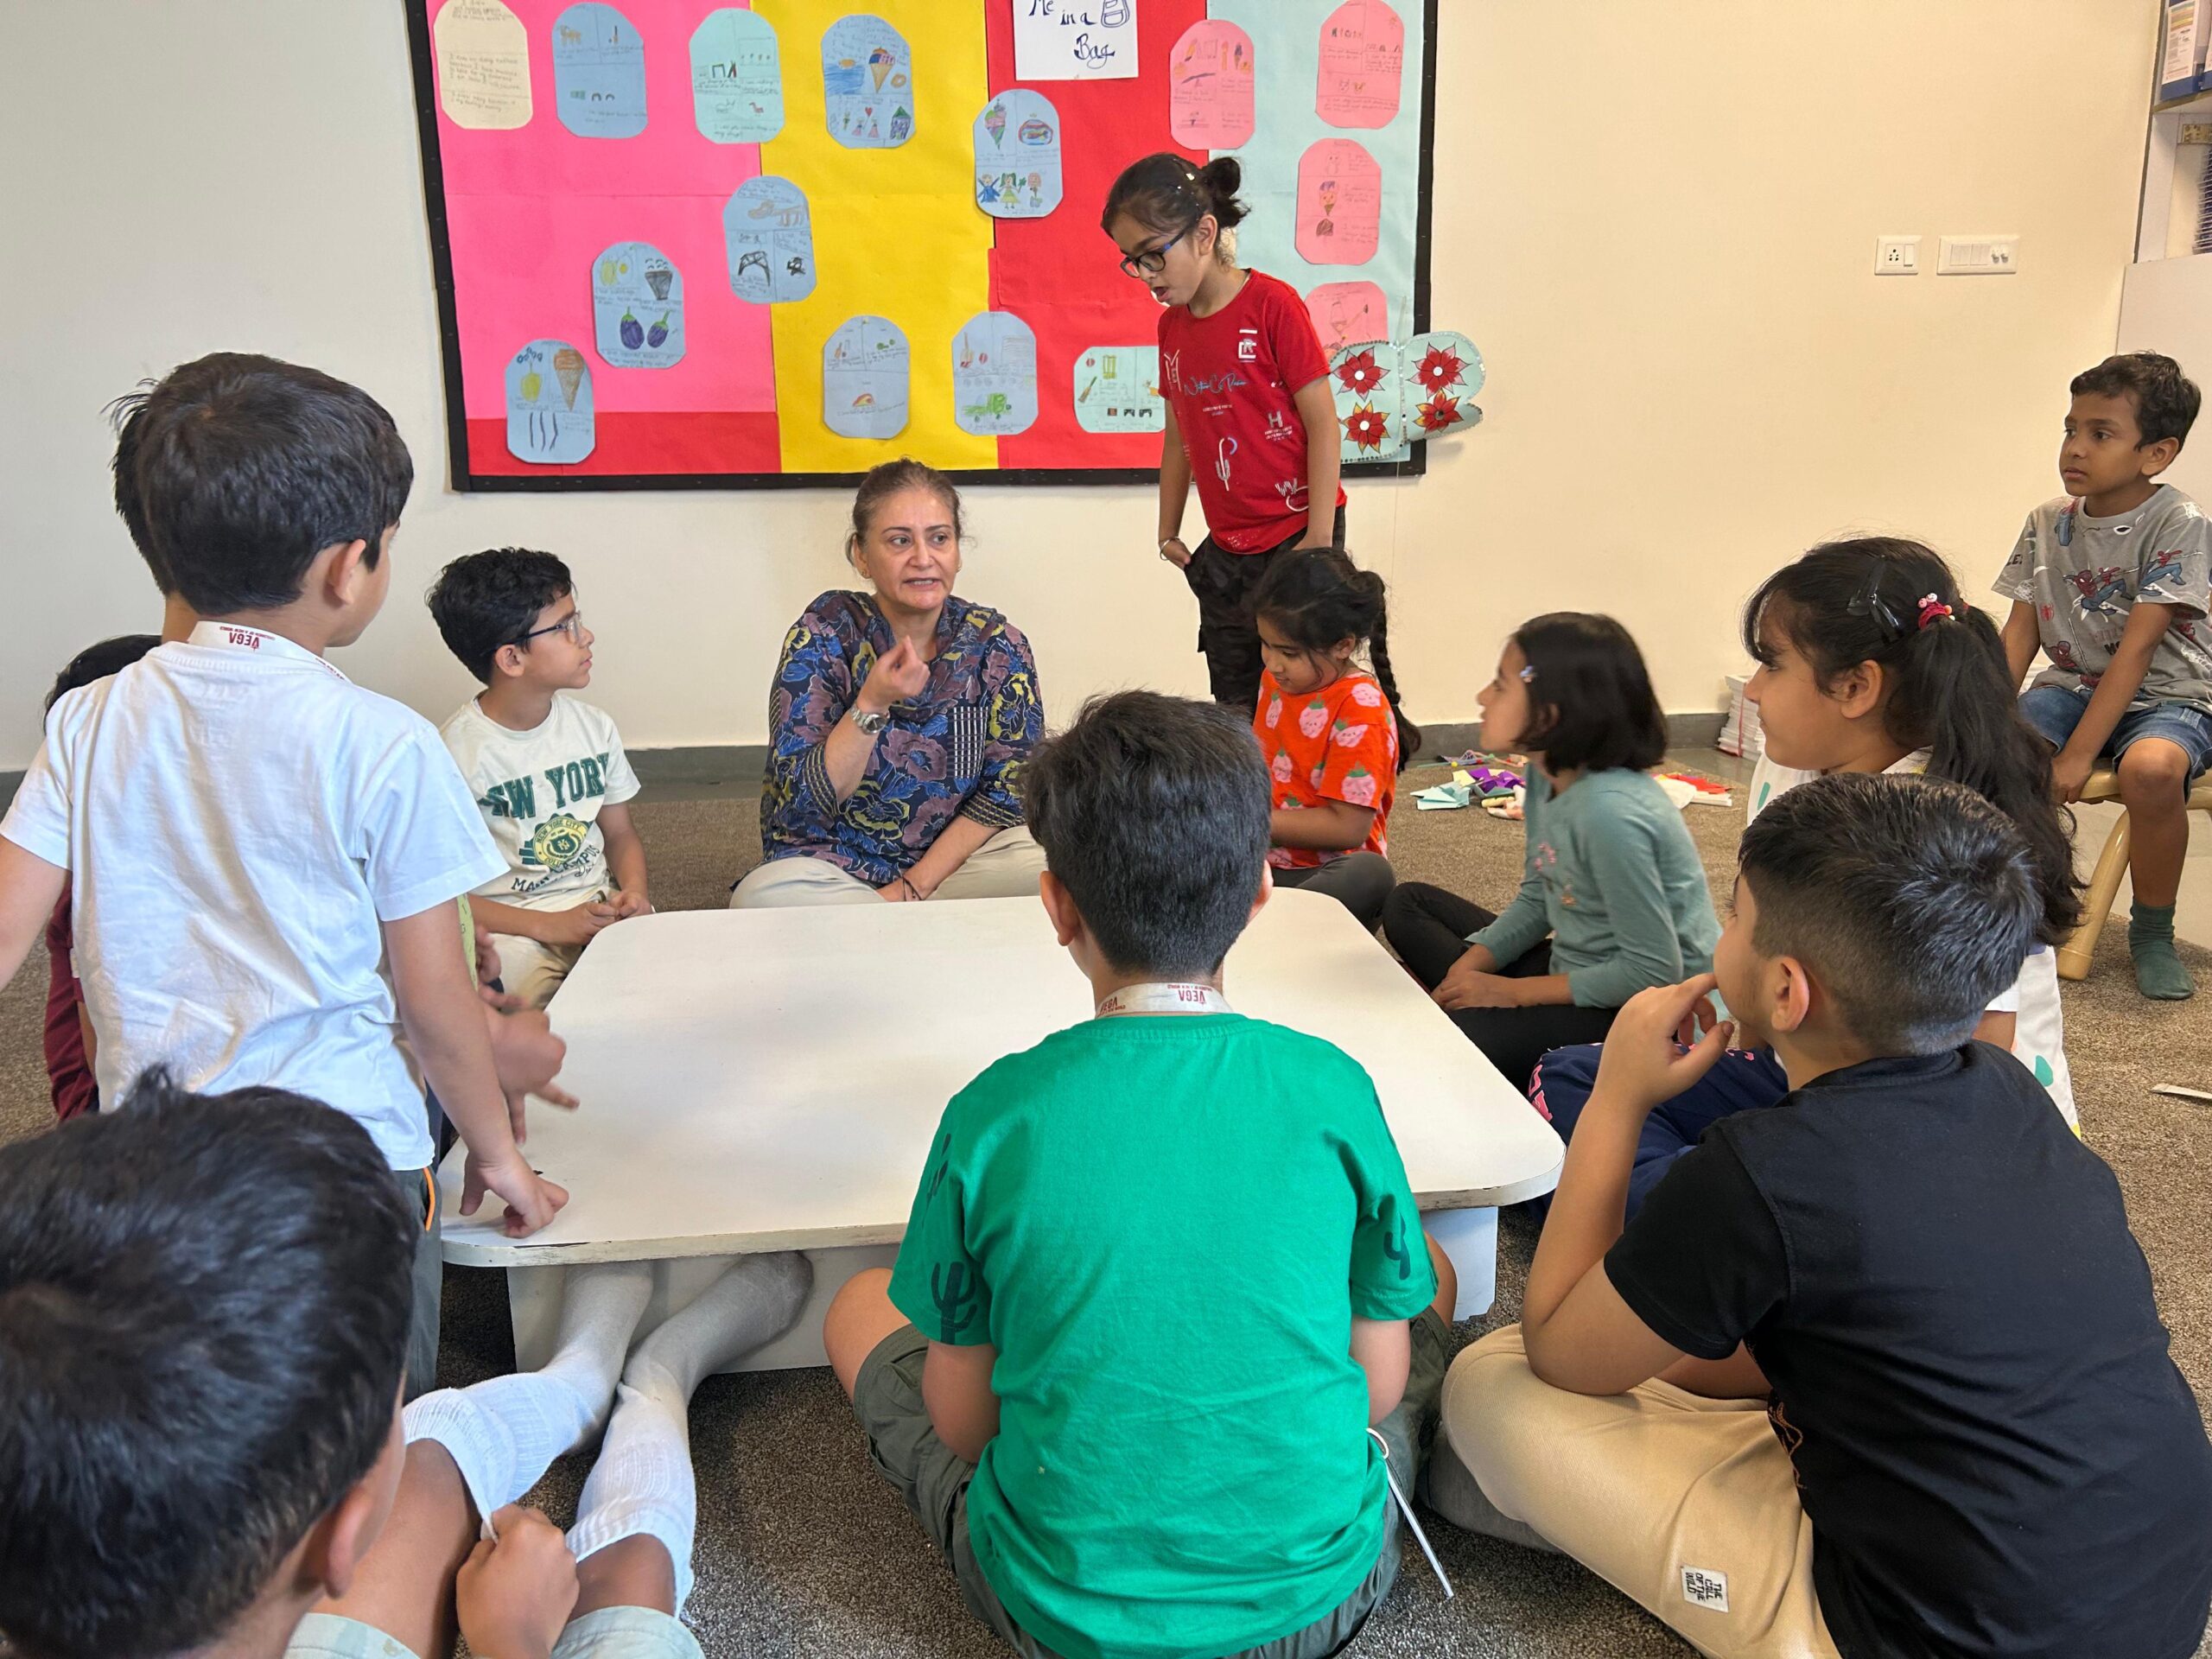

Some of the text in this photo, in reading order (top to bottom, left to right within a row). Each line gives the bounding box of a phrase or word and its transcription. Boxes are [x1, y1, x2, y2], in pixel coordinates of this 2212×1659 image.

[1028, 0, 1098, 26] Me in a
[1073, 33, 1116, 70] Bag
[228, 632, 260, 650] VEGA
[1179, 988, 1206, 1005] VEGA
